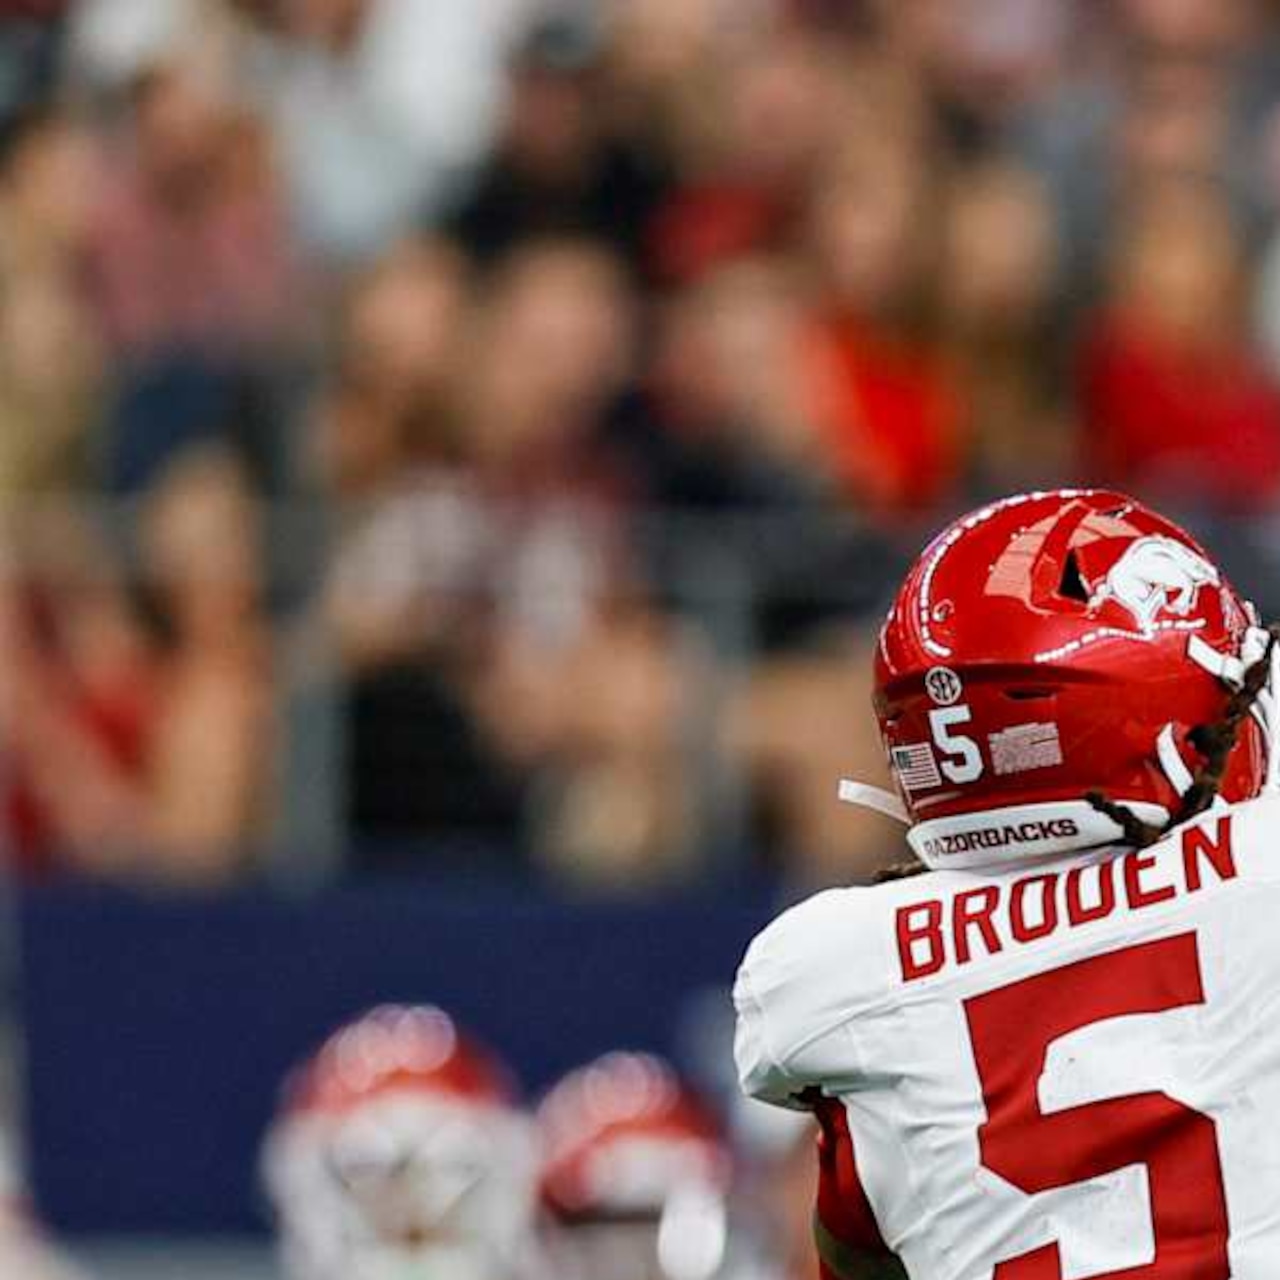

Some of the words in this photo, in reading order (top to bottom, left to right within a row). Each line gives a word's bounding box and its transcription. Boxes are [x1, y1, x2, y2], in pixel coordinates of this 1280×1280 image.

[926, 667, 962, 704] SEC
[928, 704, 984, 784] 5
[923, 819, 1079, 858] RAZORBACKS
[895, 815, 1238, 982] BRODEN
